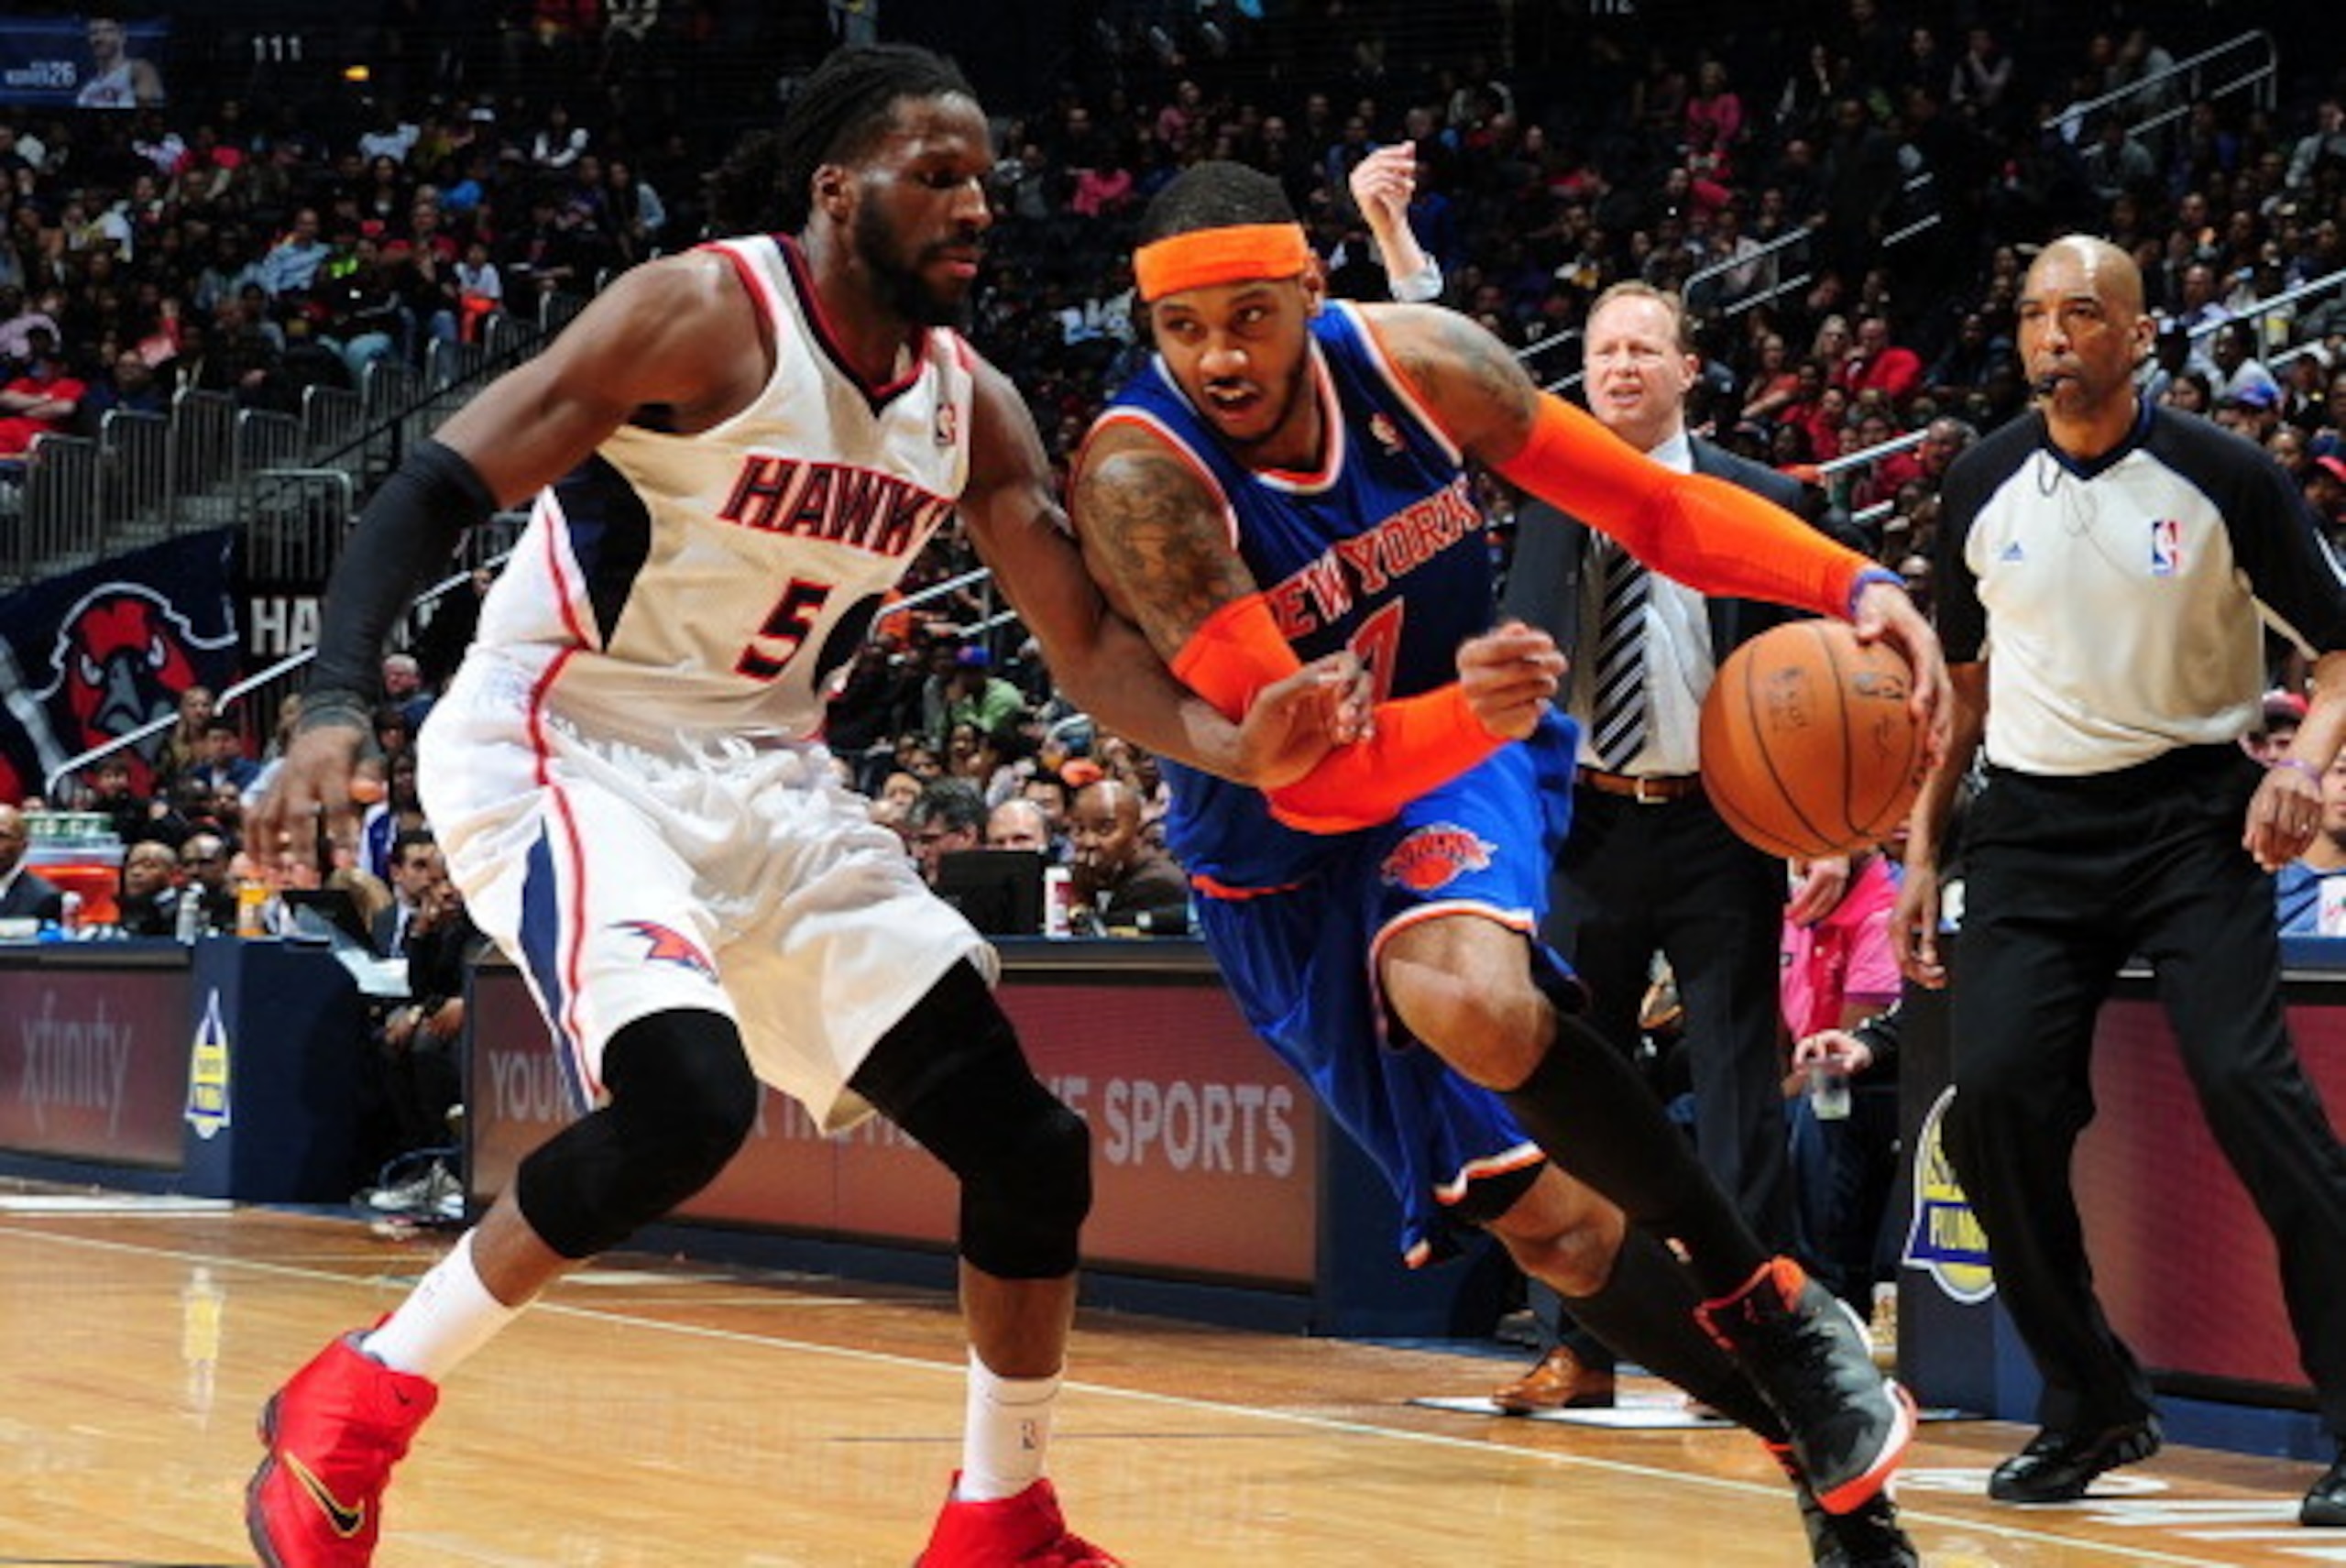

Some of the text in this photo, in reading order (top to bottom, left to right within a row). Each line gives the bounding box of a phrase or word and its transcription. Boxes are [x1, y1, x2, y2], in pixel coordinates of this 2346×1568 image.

[252, 37, 301, 62] 111
[1335, 472, 1483, 595] YORK
[734, 577, 834, 683] 5
[20, 989, 132, 1138] xfinity
[1104, 1076, 1295, 1179] SPORTS
